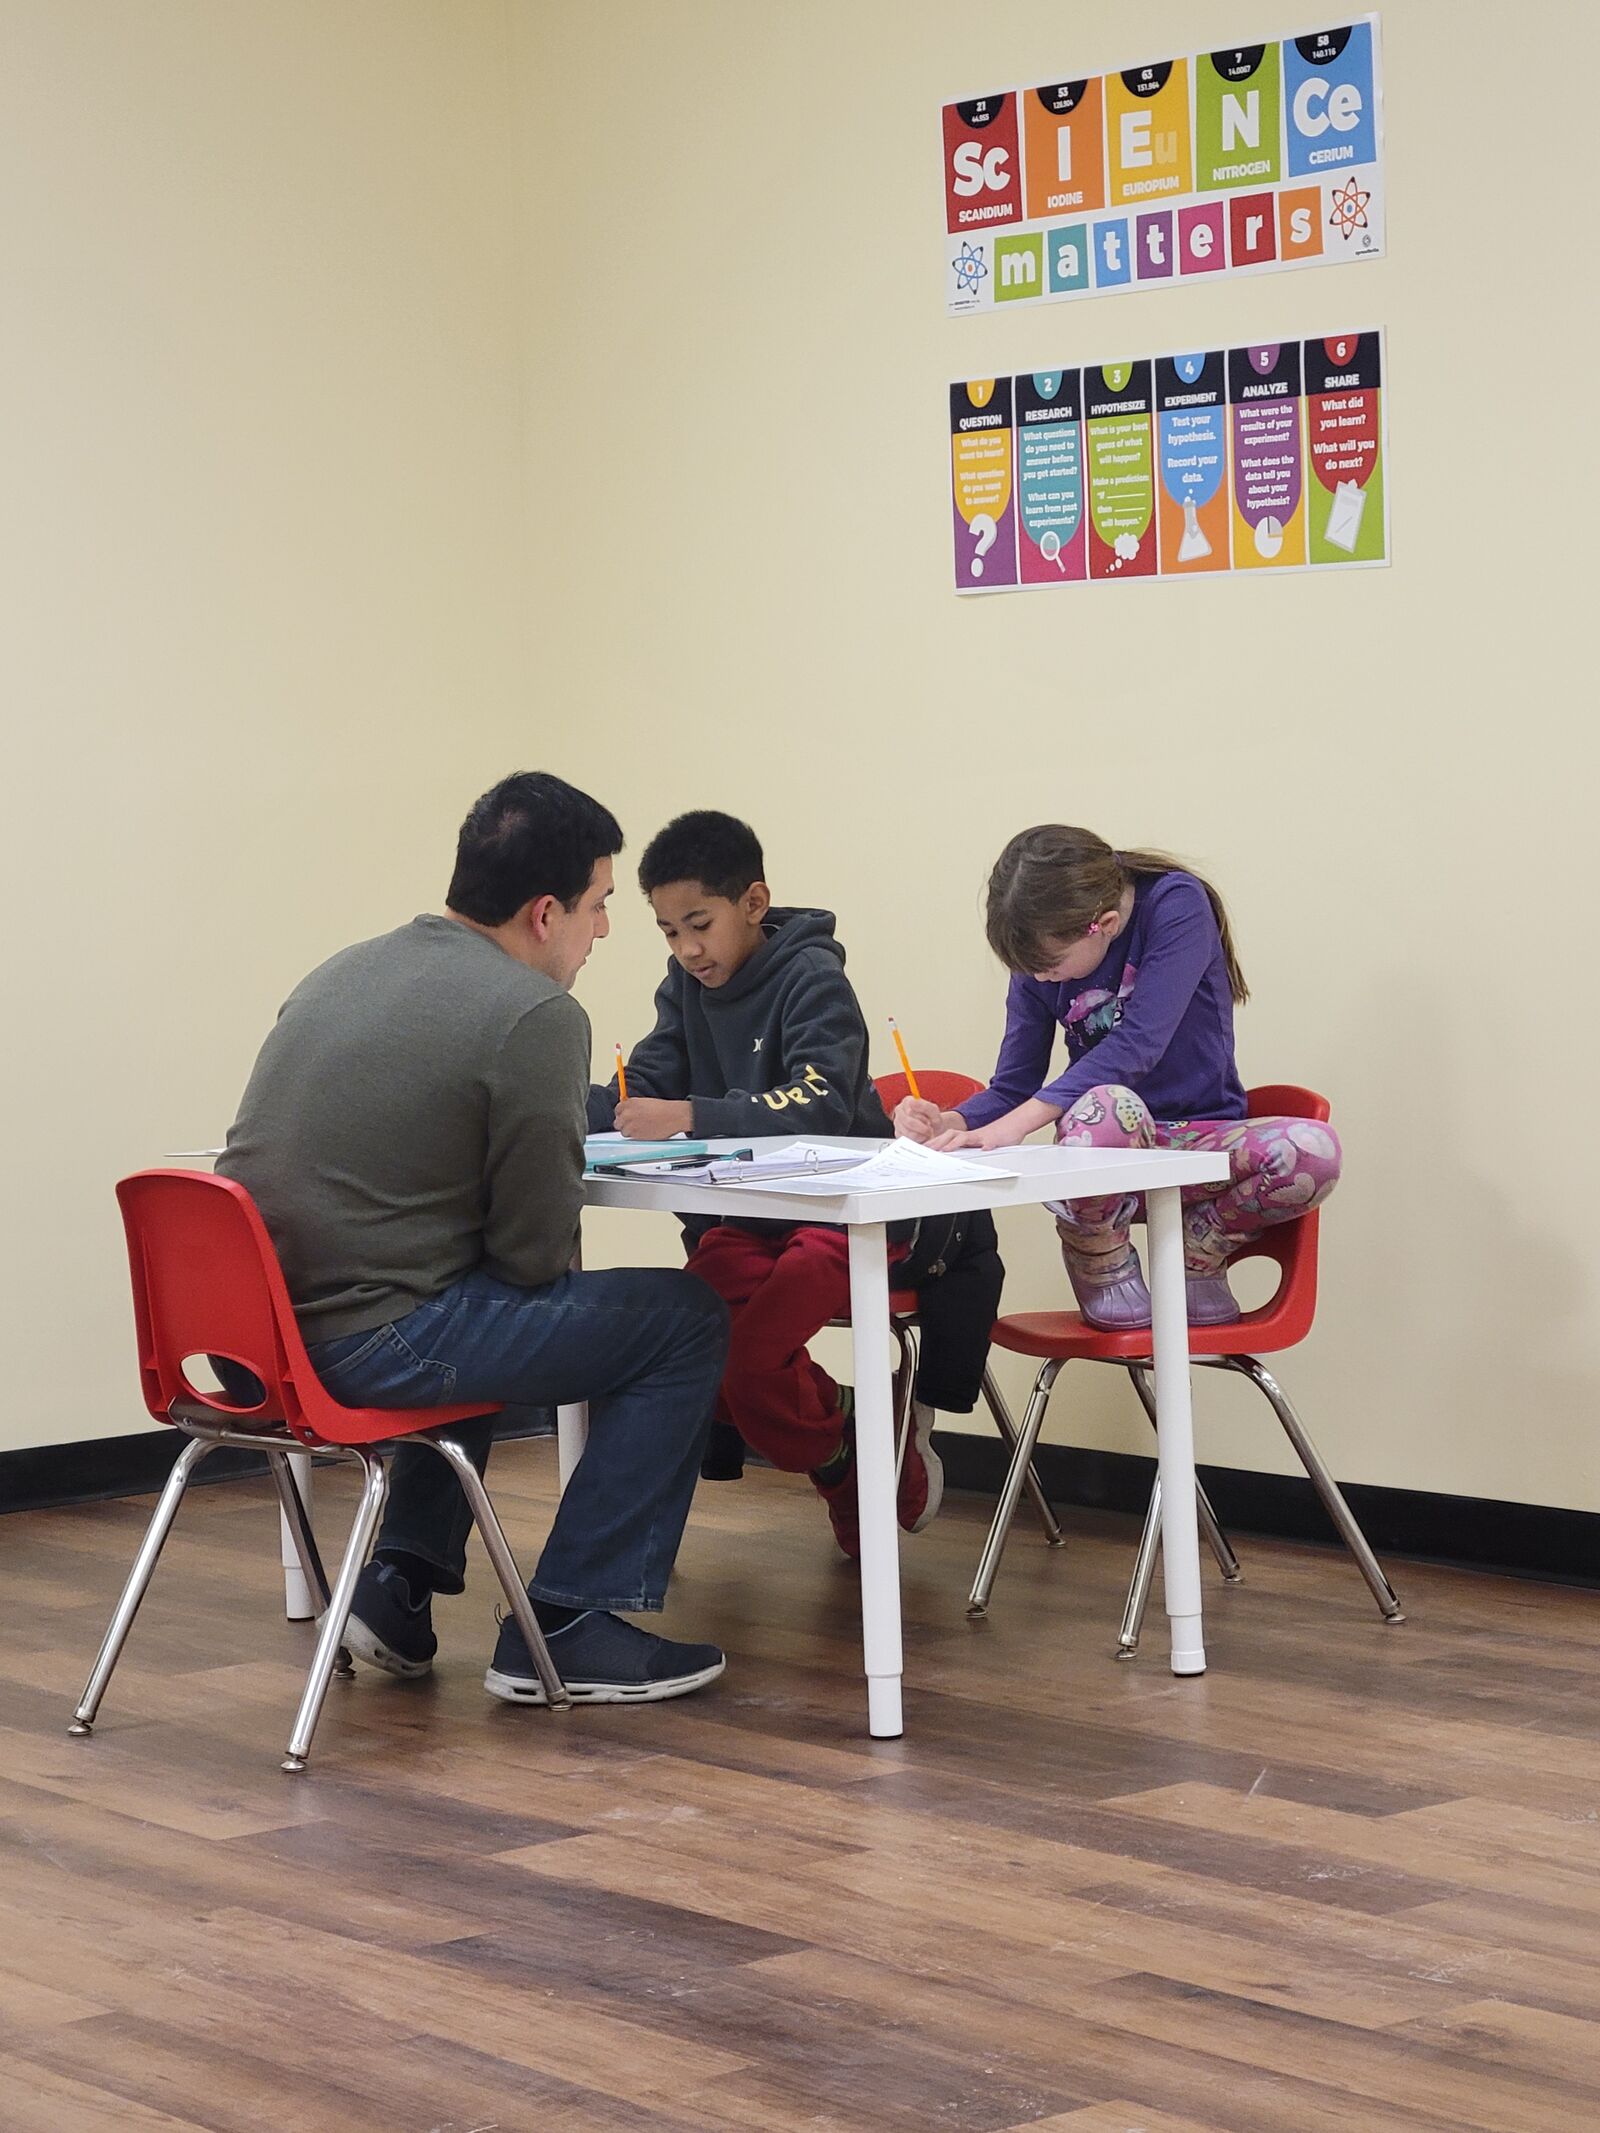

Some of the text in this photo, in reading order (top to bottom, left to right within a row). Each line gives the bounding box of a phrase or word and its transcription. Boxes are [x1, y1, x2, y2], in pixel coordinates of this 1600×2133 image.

[1317, 35, 1329, 46] 58
[1235, 53, 1242, 63] 7
[1142, 69, 1153, 79] 63
[1058, 87, 1068, 97] 53
[976, 101, 986, 112] 21
[1293, 77, 1362, 138] Ce
[1222, 90, 1260, 152] N
[1058, 125, 1071, 182] I
[1308, 145, 1353, 164] CERIUM
[952, 141, 1011, 197] Sc
[1212, 160, 1270, 181] NITROGEN
[1122, 176, 1180, 196] EUROPIUM
[1048, 192, 1083, 208] IODINE
[958, 203, 1012, 222] SCANDIUM
[1336, 342, 1346, 357] 6
[1260, 352, 1268, 366] 5
[1185, 361, 1194, 375] 4
[1114, 369, 1121, 384] 3
[1324, 374, 1360, 388] SHARE
[1044, 378, 1052, 391] 2
[1243, 382, 1288, 398] ANALYZE
[978, 386, 984, 400] 1
[1164, 392, 1217, 407] EXPERIMENT
[1091, 400, 1146, 415] HYPOTHESIZE
[1322, 396, 1364, 411] What did
[1025, 406, 1072, 422] RESEARCH
[1240, 405, 1293, 418] What were the
[960, 414, 1002, 430] QUESTION
[1172, 415, 1211, 428] Test your
[1241, 419, 1293, 432] results of your
[1320, 414, 1366, 431] you learn?
[1024, 429, 1075, 441] What questions
[1116, 424, 1131, 434] your
[1168, 429, 1217, 446] hypothesis.
[1244, 432, 1290, 446] experiment?
[1025, 446, 1034, 454] do
[1035, 445, 1048, 454] you
[1313, 439, 1375, 454] What will you
[1168, 455, 1218, 468] Record your
[1241, 455, 1294, 468] What does the
[1325, 456, 1364, 470] do next?
[1023, 467, 1077, 480] you get started?
[1182, 473, 1204, 483] data.
[1245, 470, 1291, 481] data tell you
[1248, 484, 1288, 494] about your
[1028, 493, 1046, 502] What
[1061, 492, 1074, 500] you
[1247, 496, 1290, 509] hypothesis?
[1045, 504, 1061, 513] from
[1062, 503, 1077, 513] past
